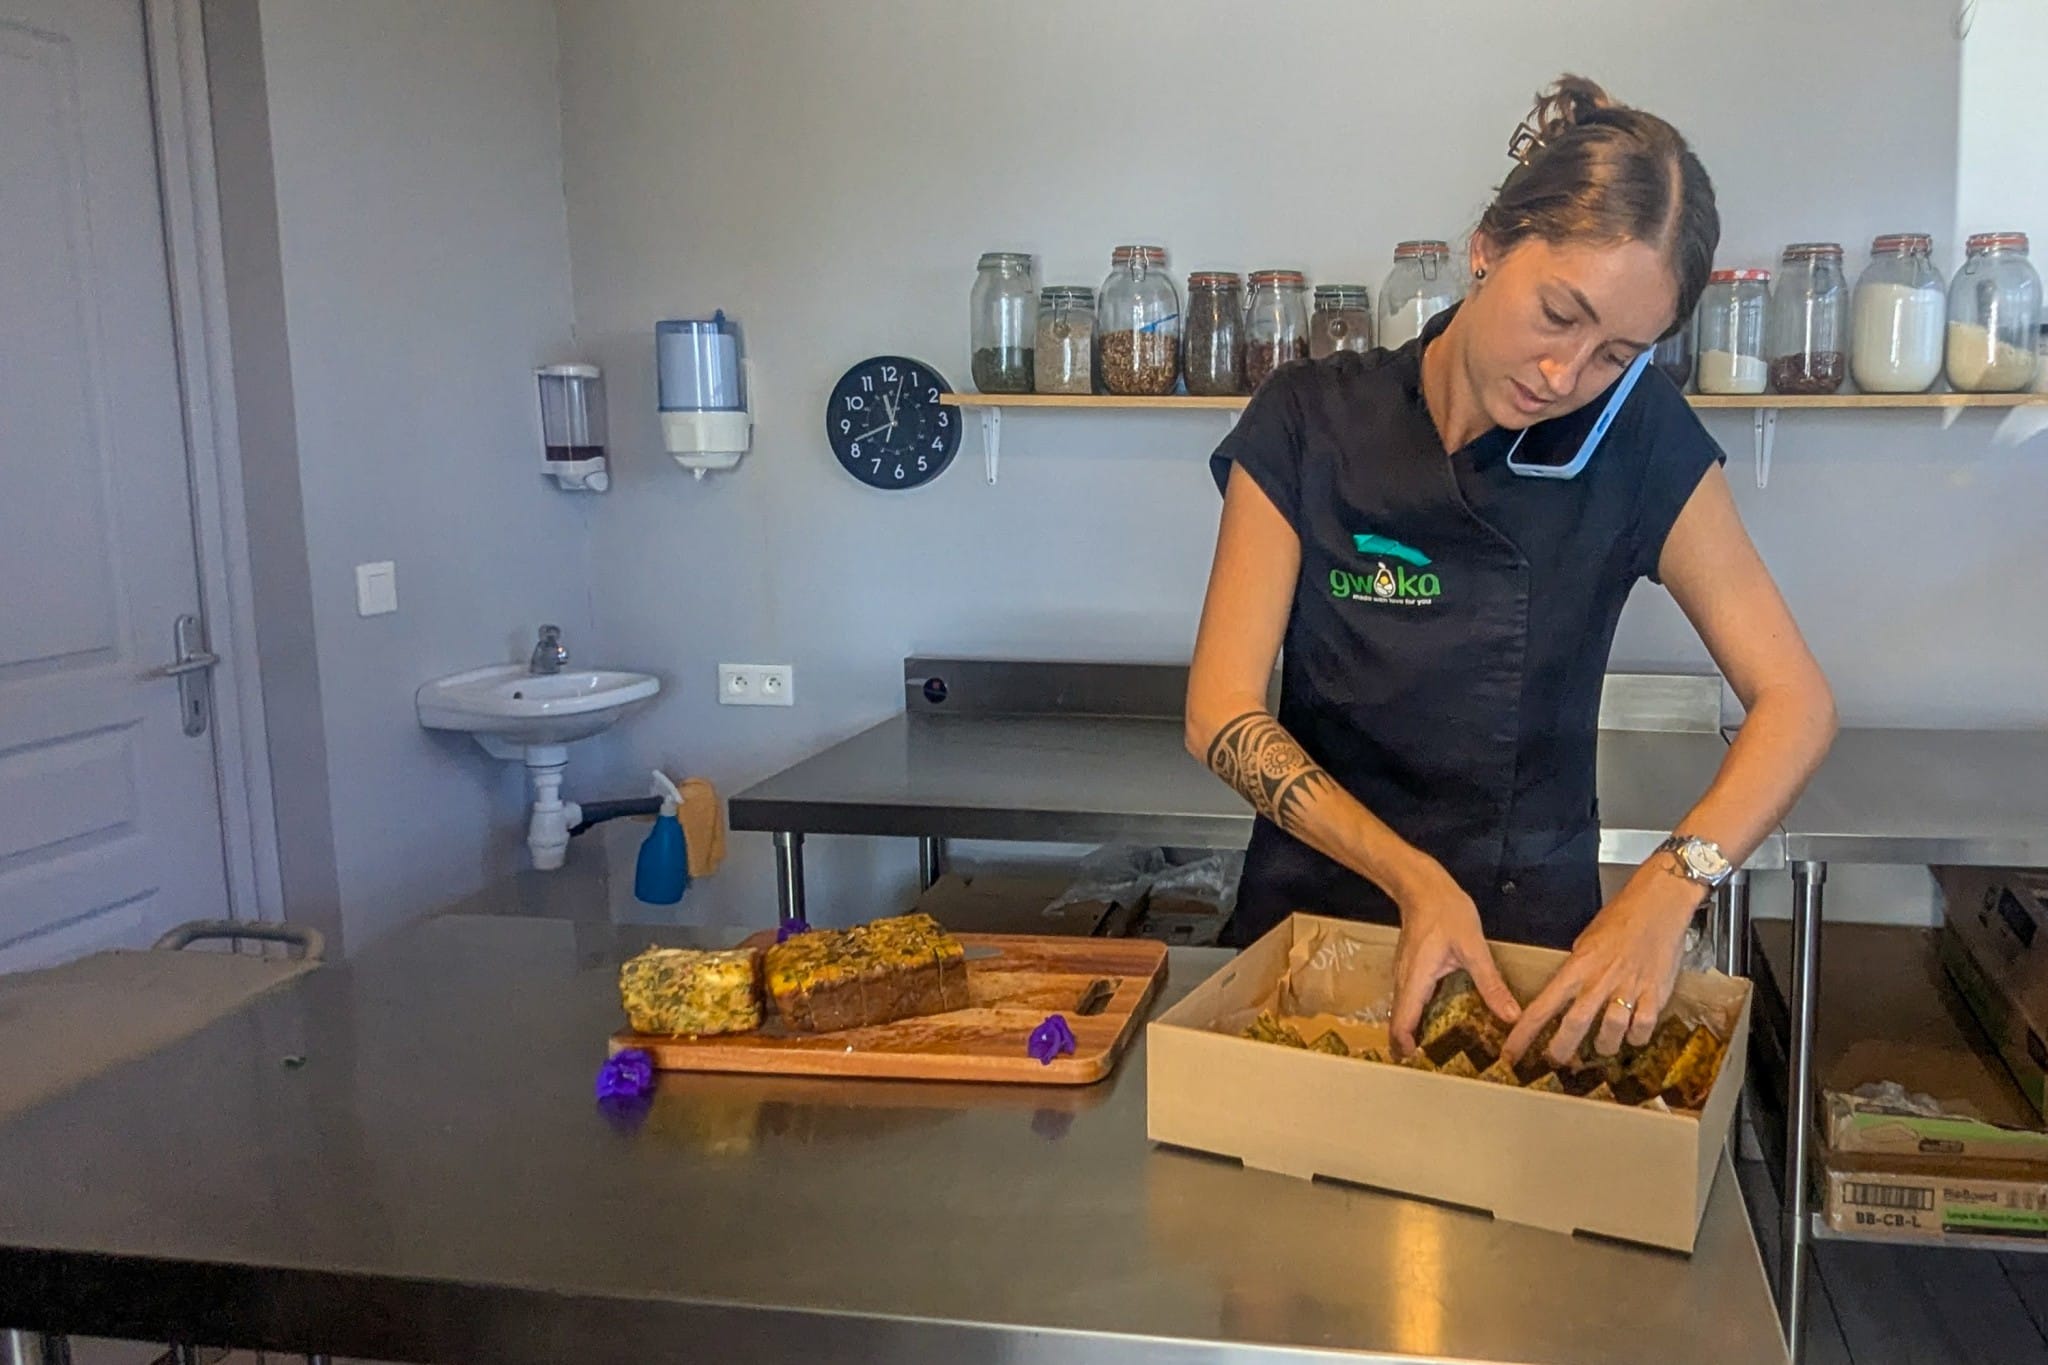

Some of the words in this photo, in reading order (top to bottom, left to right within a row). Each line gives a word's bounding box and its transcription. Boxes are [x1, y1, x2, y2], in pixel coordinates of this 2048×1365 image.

[881, 366, 898, 382] 12
[911, 371, 918, 387] 1
[861, 376, 873, 392] 11
[844, 396, 864, 410] 10
[927, 388, 939, 403] 2
[840, 419, 851, 435] 9
[938, 412, 948, 427] 3
[850, 443, 860, 458] 8
[931, 436, 943, 451] 4
[871, 458, 881, 474] 7
[917, 456, 927, 471] 5
[894, 464, 905, 479] 6
[1329, 562, 1441, 598] gwoka
[1855, 1211, 1922, 1228] BB-CB-L
